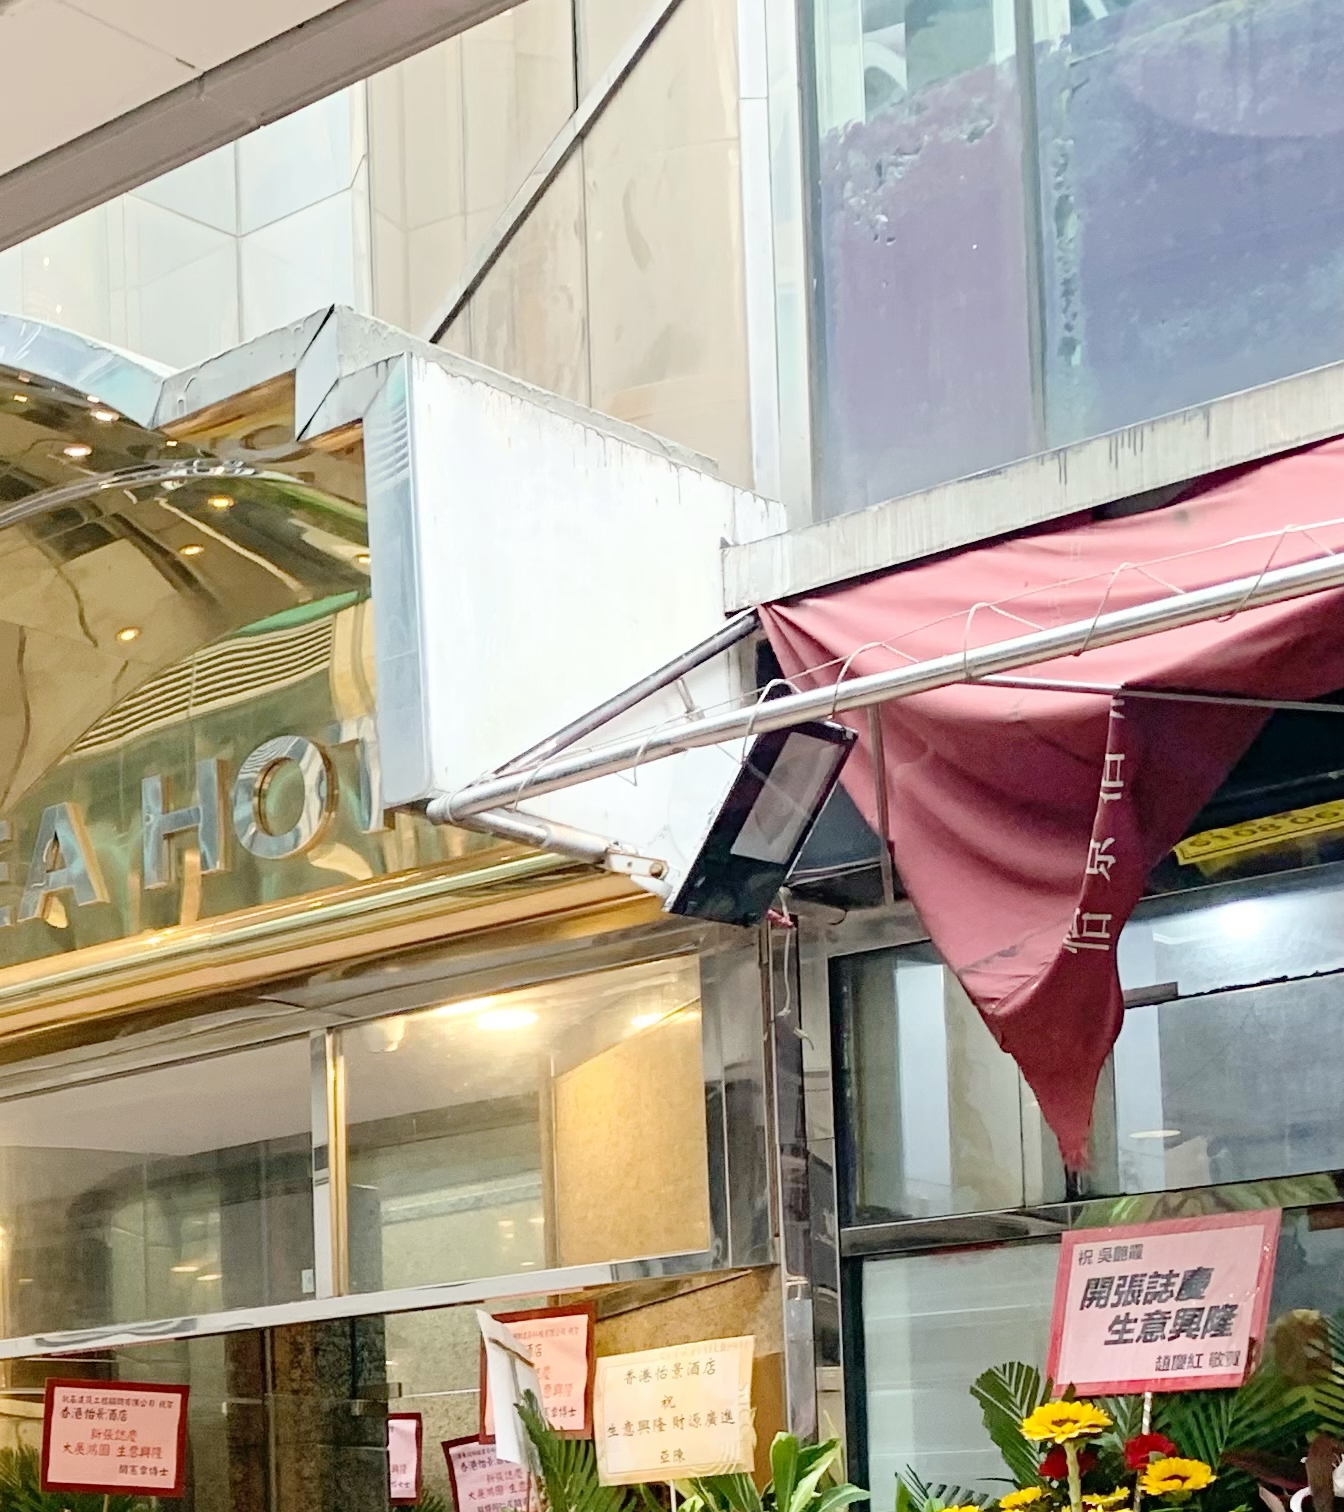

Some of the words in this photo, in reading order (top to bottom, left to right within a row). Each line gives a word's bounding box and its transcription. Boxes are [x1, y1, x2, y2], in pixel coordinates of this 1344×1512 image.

[1079, 1266, 1215, 1311] 開張誌慶
[1103, 1303, 1239, 1346] 生意興隆
[623, 1357, 717, 1386] 香港怡景酒店
[60, 1406, 129, 1422] 香港怡景酒店
[606, 1416, 668, 1438] 生意興隆
[672, 1408, 736, 1431] 財源廣進
